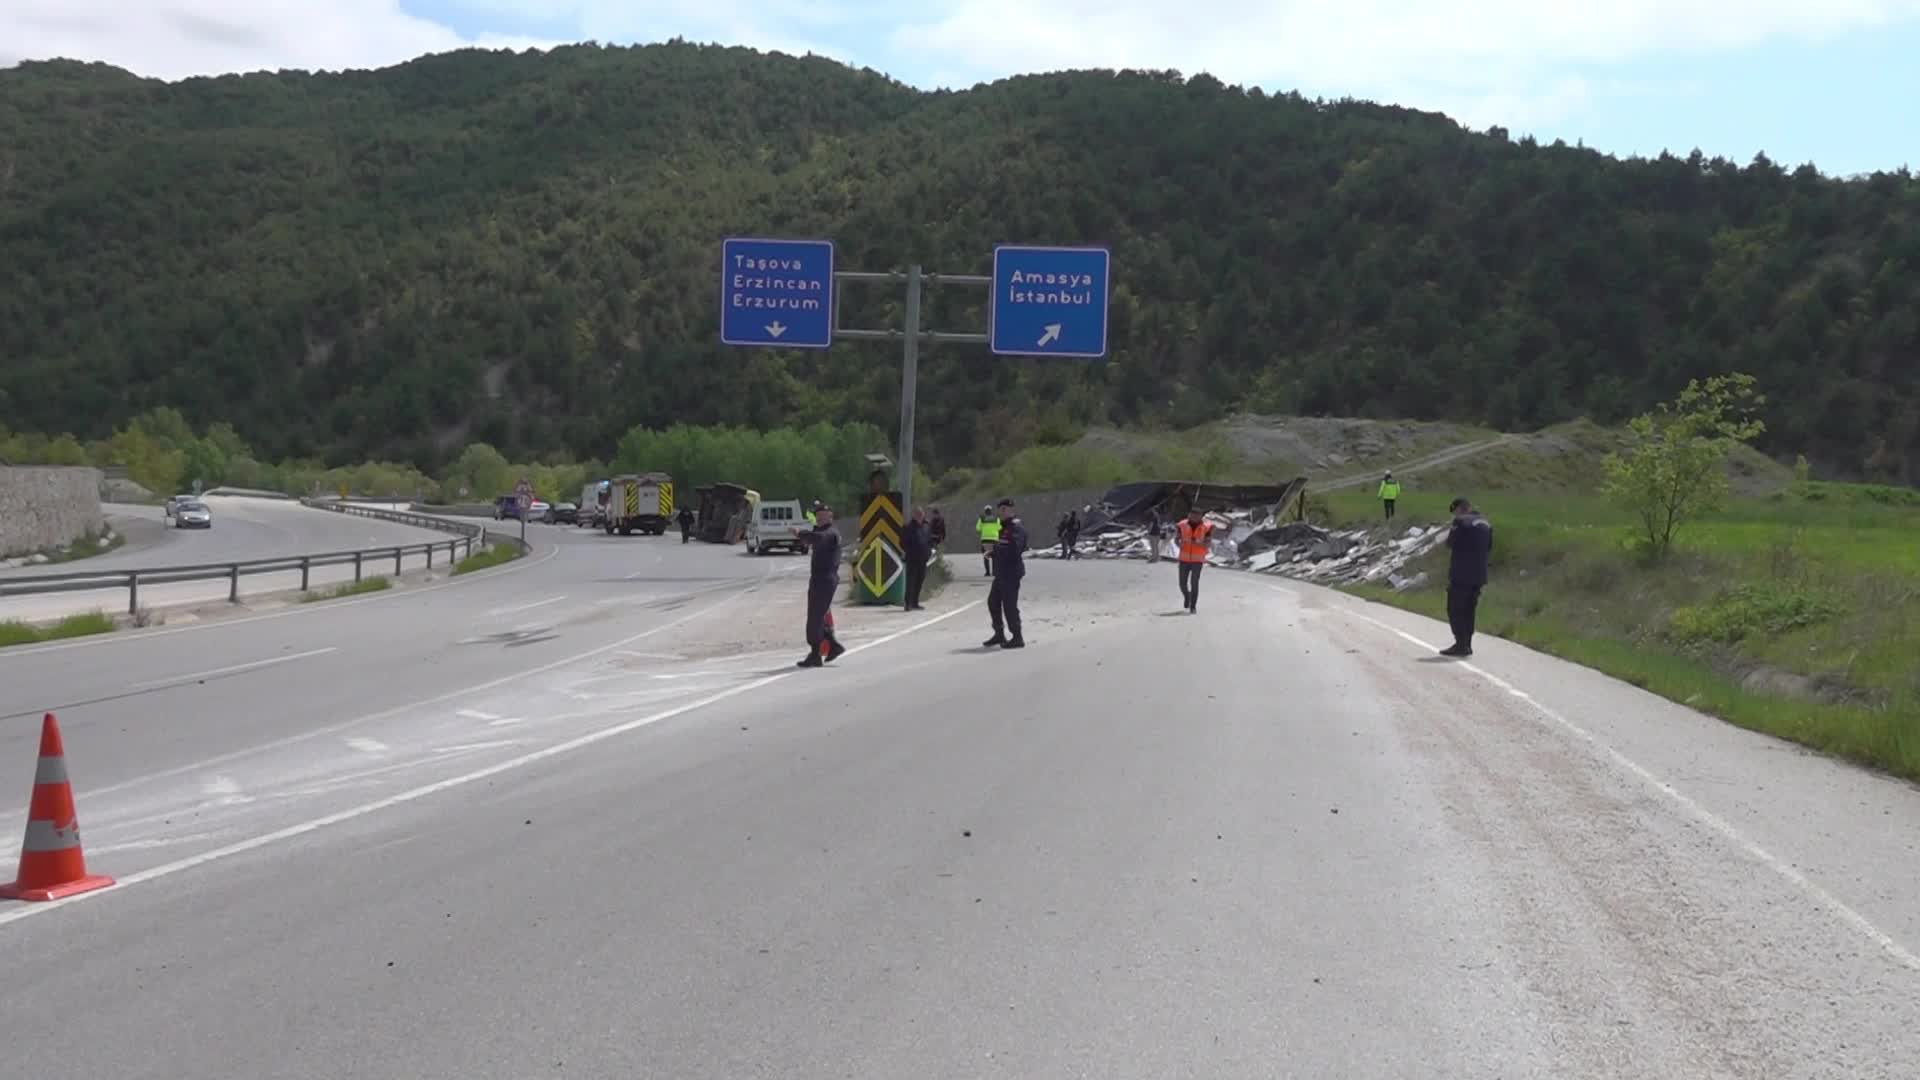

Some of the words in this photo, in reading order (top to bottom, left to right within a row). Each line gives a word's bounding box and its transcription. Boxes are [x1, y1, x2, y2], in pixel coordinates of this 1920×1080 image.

[735, 255, 801, 270] Taşova
[734, 275, 820, 290] Erzincan
[1011, 269, 1092, 288] Amasya
[733, 293, 819, 309] Erzurum
[1010, 285, 1090, 304] İstanbul
